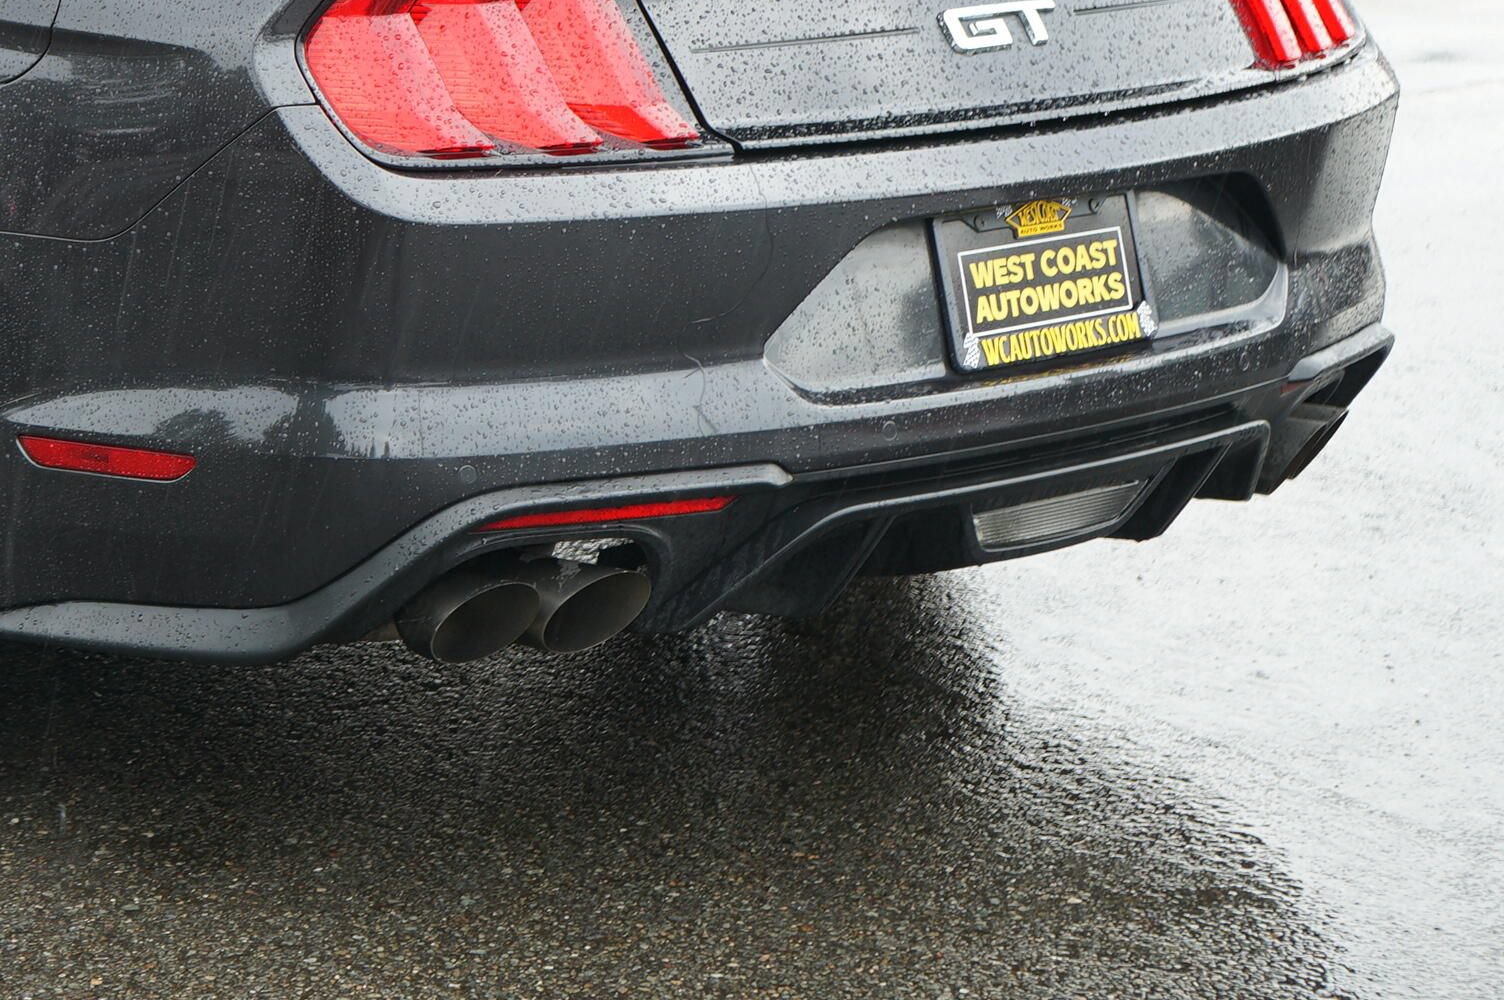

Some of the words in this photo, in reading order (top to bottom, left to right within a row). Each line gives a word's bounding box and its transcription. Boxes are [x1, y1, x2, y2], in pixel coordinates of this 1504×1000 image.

[938, 0, 1056, 55] GT
[969, 252, 1035, 289] WEST
[1040, 239, 1118, 277] COAST
[976, 272, 1126, 324] AUTOWORKS
[981, 311, 1142, 366] WCAUTOWORKS.COM
